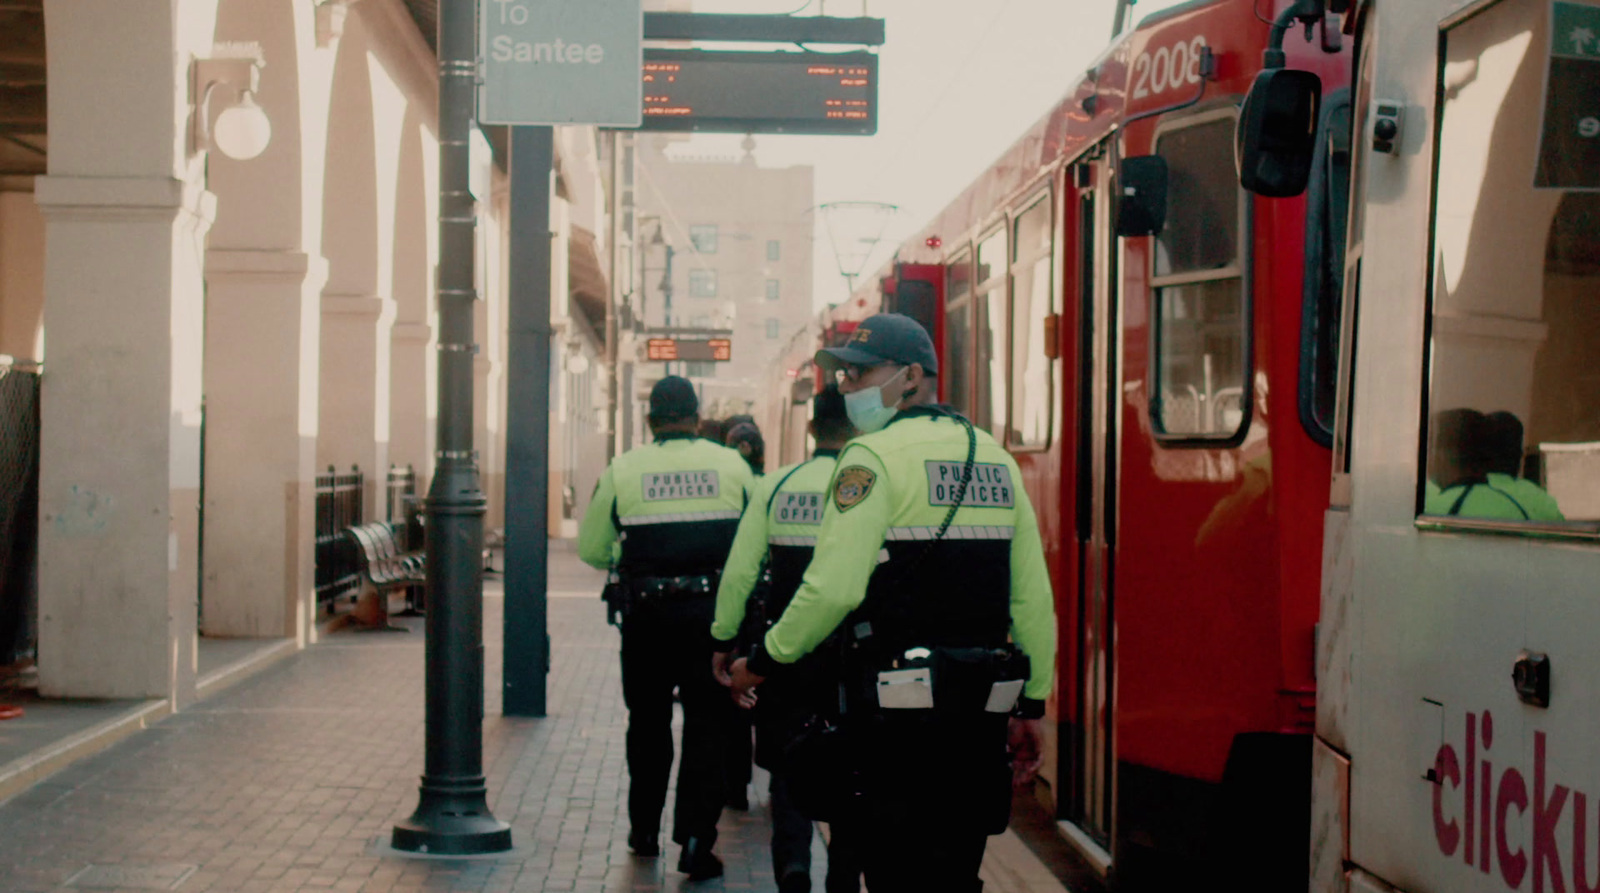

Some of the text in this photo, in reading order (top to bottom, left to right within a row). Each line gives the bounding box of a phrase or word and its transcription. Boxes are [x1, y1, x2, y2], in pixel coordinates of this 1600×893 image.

[493, 0, 529, 25] To
[491, 35, 604, 64] Santee
[1133, 34, 1206, 99] 2008
[653, 472, 708, 485] PUBLIC
[939, 465, 1002, 483] PULIC
[648, 484, 714, 498] OFFICER
[936, 484, 1010, 503] OFICER
[781, 507, 823, 521] OFFI
[1432, 709, 1600, 893] clicku
